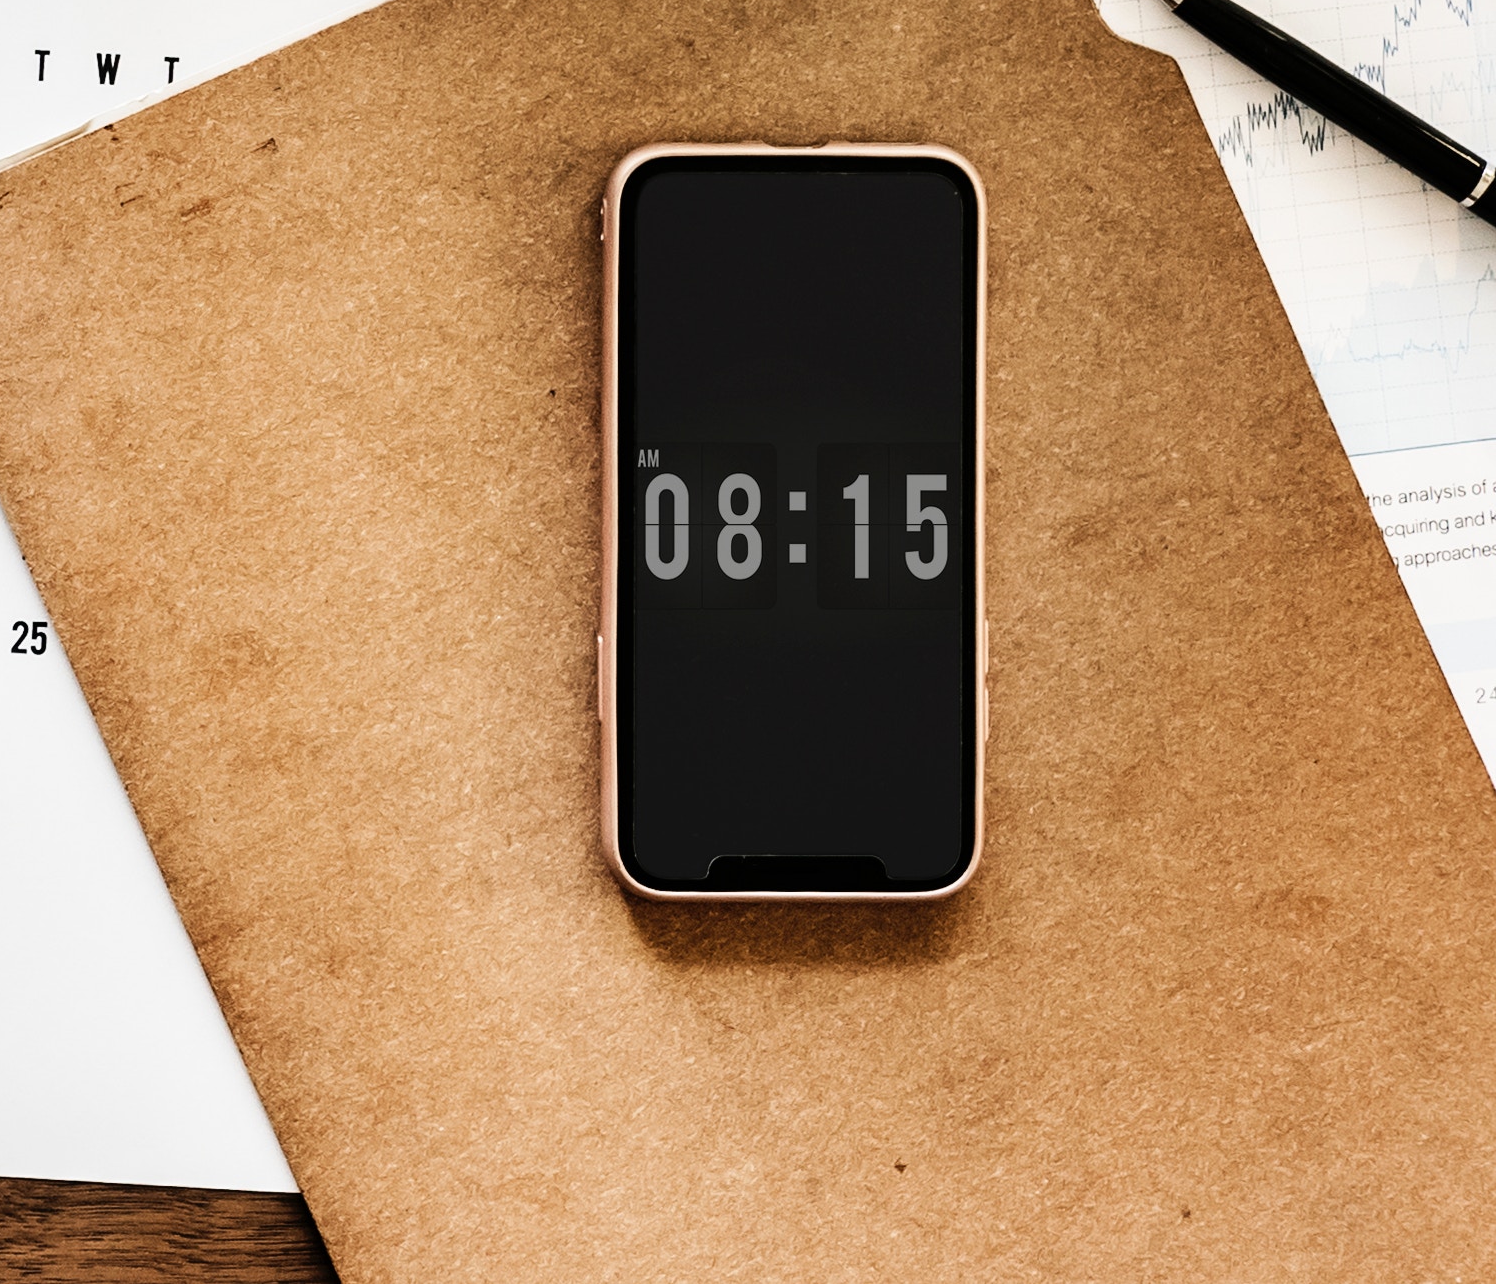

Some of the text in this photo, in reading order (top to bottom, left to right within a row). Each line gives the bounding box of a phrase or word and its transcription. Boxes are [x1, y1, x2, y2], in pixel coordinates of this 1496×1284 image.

[35, 50, 50, 81] T
[97, 53, 120, 85] W
[165, 57, 179, 83] T
[638, 450, 658, 467] AM
[645, 473, 948, 580] 08:15
[11, 621, 47, 655] 25
